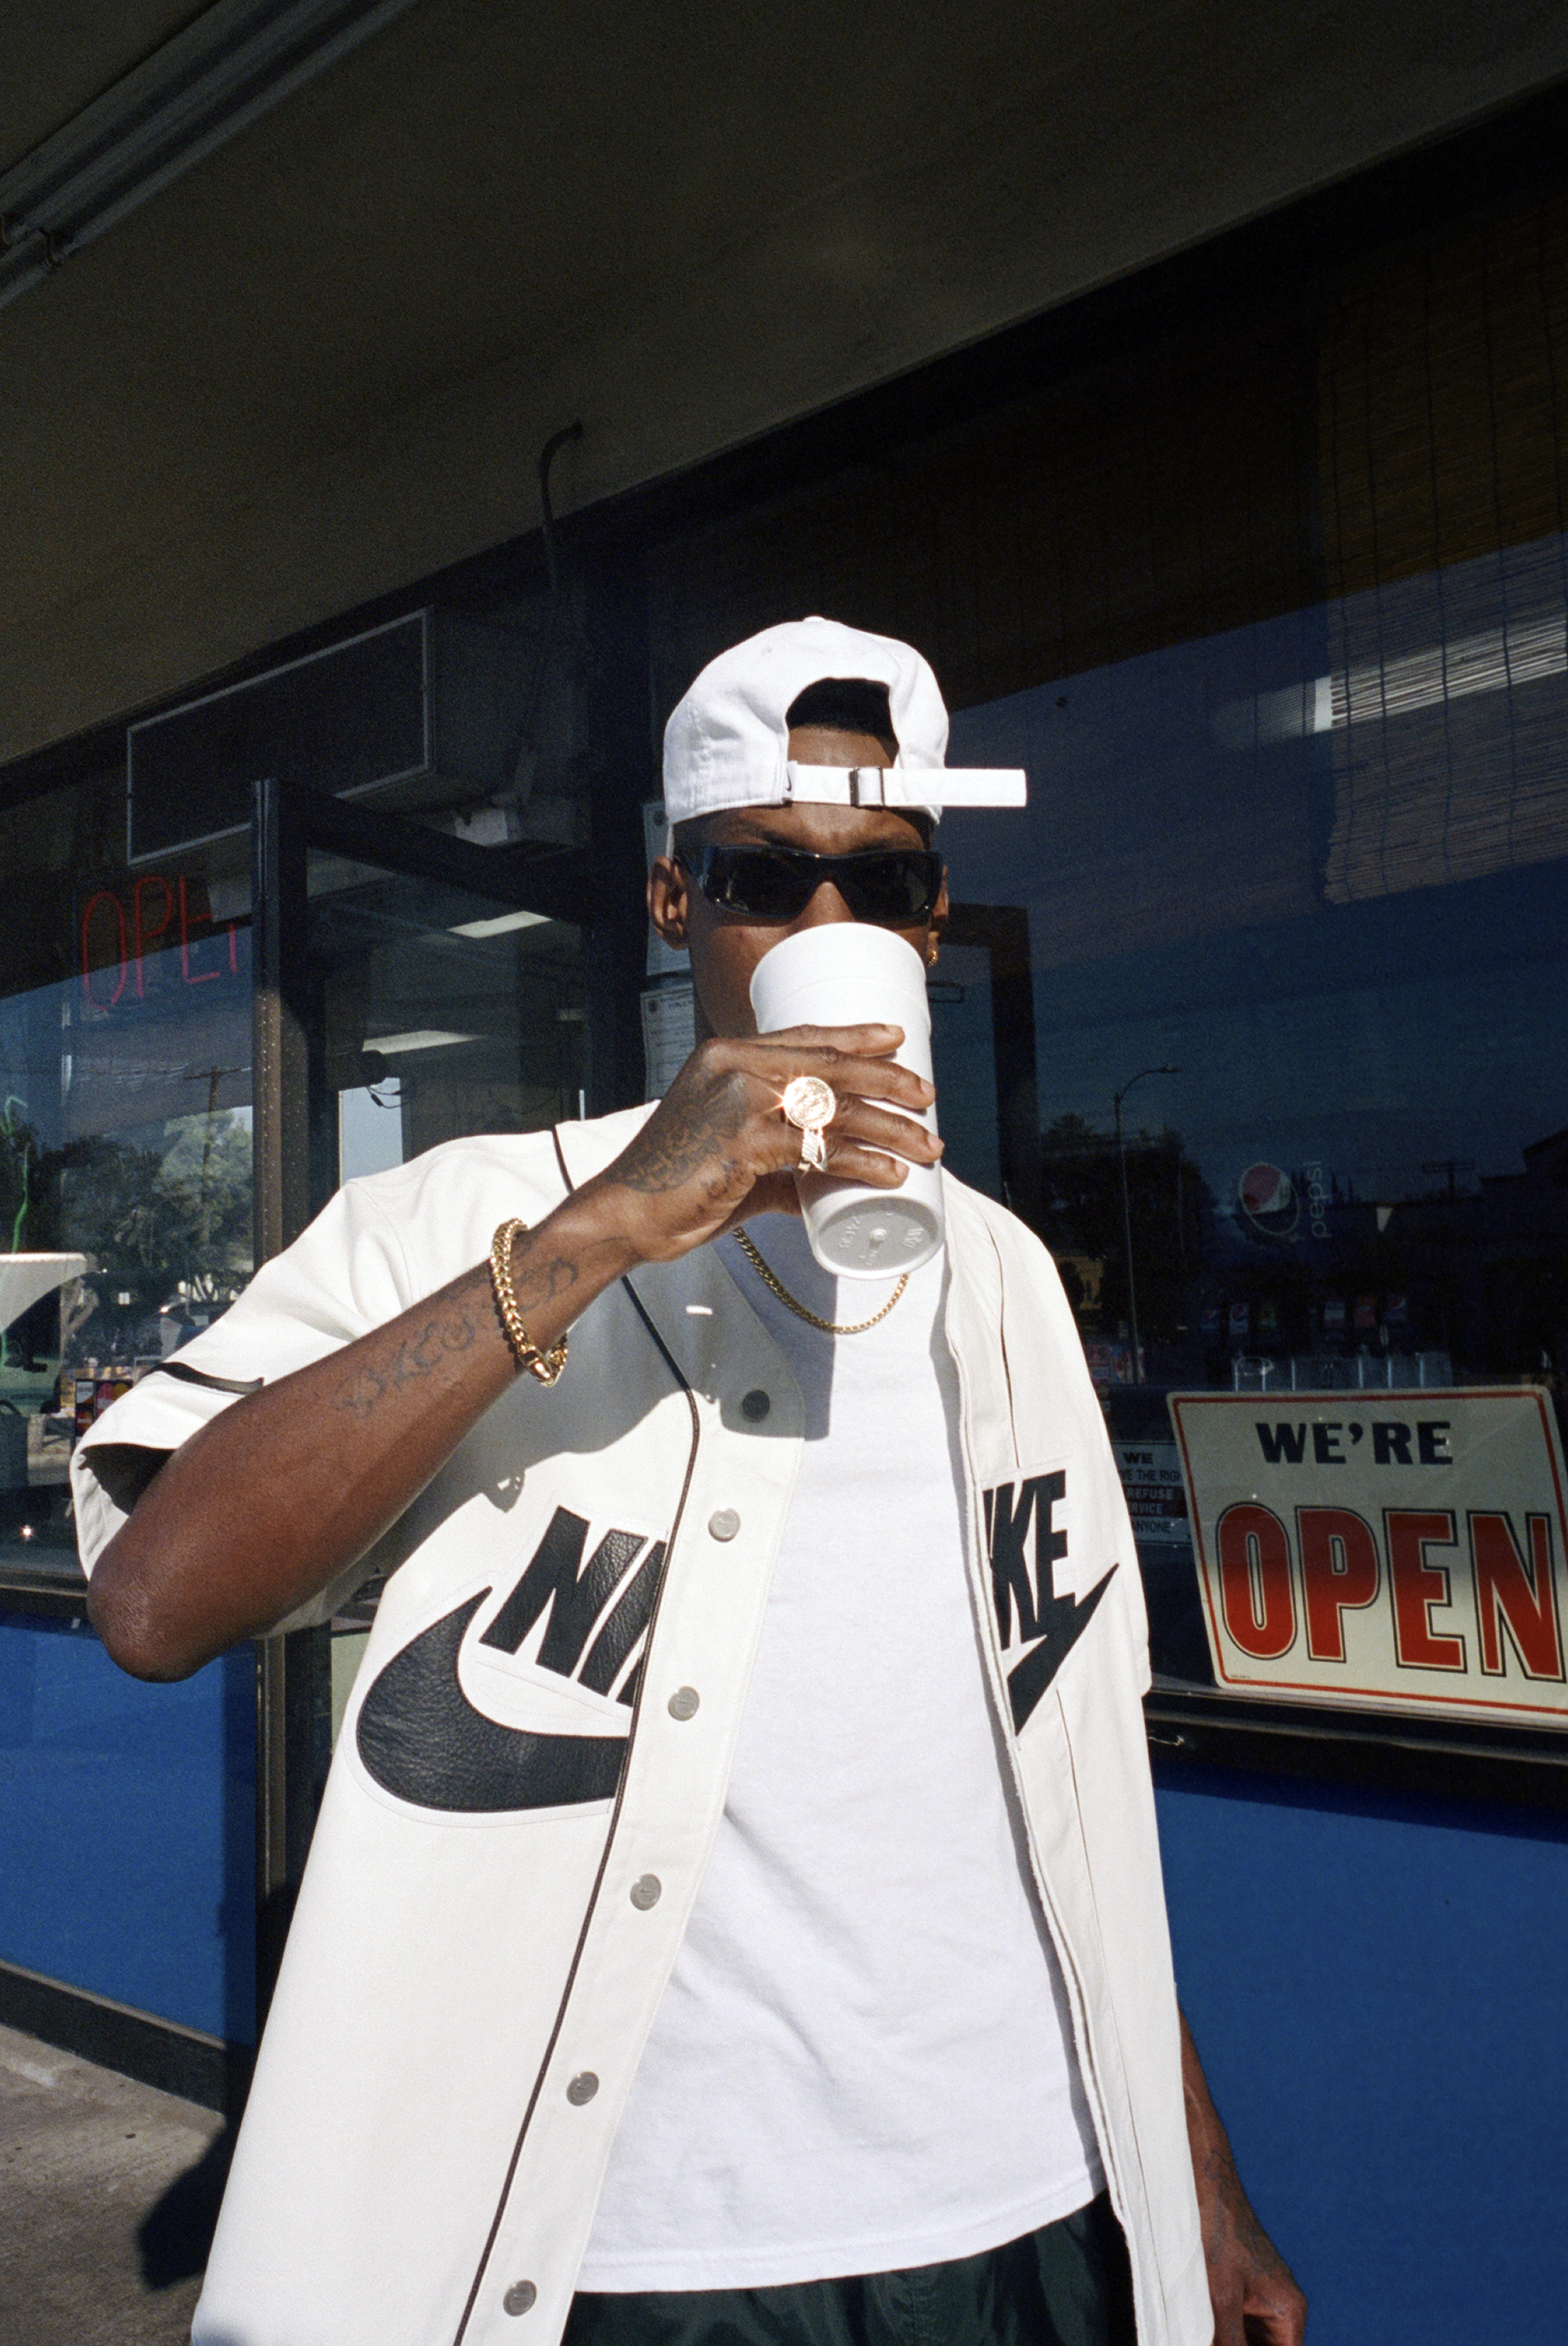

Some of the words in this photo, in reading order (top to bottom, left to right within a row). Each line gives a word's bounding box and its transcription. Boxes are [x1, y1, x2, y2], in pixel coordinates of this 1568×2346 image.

[81, 875, 238, 1012] OPE
[1303, 1160, 1333, 1238] pepsi
[1255, 1421, 1453, 1465] WE'RE
[1122, 1452, 1154, 1465] WE
[1137, 1469, 1156, 1482] THE
[1126, 1487, 1174, 1500] REFUSE
[1129, 1502, 1163, 1514] RVICE
[1216, 1501, 1567, 1683] OPEN
